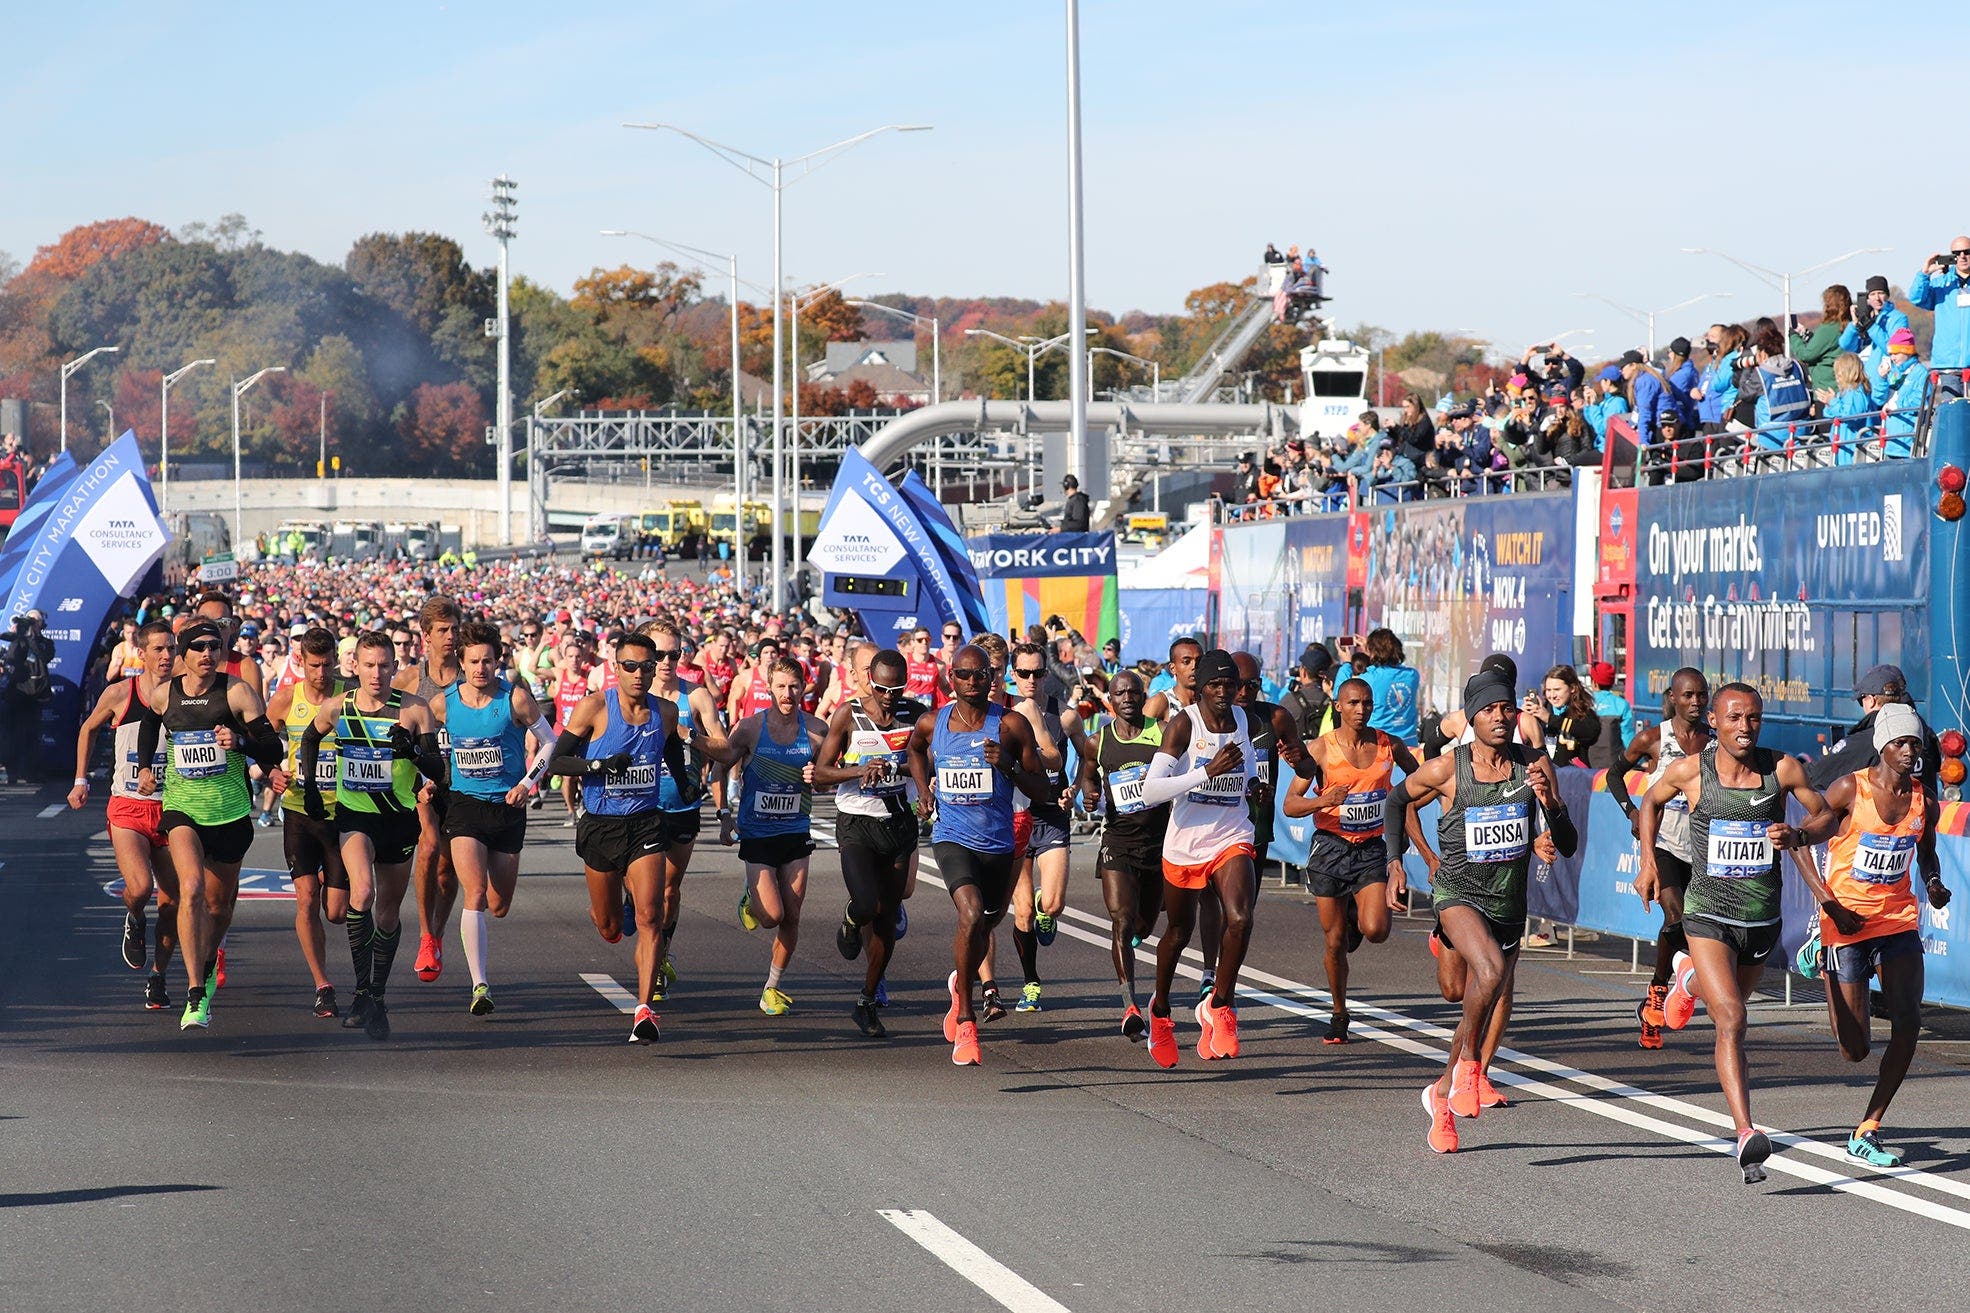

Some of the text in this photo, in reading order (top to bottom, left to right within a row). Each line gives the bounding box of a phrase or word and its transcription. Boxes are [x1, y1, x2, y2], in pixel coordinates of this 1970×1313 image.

[27, 545, 52, 586] CITY
[50, 453, 120, 544] MARATHON
[108, 520, 135, 528] TATA
[90, 530, 153, 539] CONSULTANCY
[843, 535, 869, 543] TATA
[862, 471, 891, 505] TCS
[888, 504, 920, 543] NEW
[917, 545, 948, 594] YORK
[1817, 511, 1881, 549] UNITED
[101, 540, 142, 549] SERVICES
[823, 544, 888, 554] CONSULTANCY
[1496, 532, 1544, 565] WATCH IT
[1649, 522, 1669, 576] On
[1673, 532, 1706, 585] your
[1710, 514, 1763, 573] marks.
[835, 554, 877, 562] SERVICES
[985, 549, 1047, 568] YORK
[1053, 547, 1111, 566] CITY
[1494, 576, 1525, 608] NOV. 4
[1648, 591, 1815, 661] Get set. Go anywhere.
[1492, 619, 1514, 652] 9AM
[181, 698, 209, 706] saucony
[181, 746, 216, 764] WARD
[455, 749, 502, 765] THOMPSON
[132, 765, 166, 780] DIES
[348, 762, 384, 779] R. VAIL
[945, 772, 983, 789] LAGAT
[760, 795, 796, 810] SMITH
[1346, 803, 1381, 821] SIMBU
[1473, 822, 1524, 846] DESISA
[1717, 840, 1765, 861] KITATA
[1864, 849, 1907, 871] TALAM
[1933, 940, 1947, 956] LIFE
